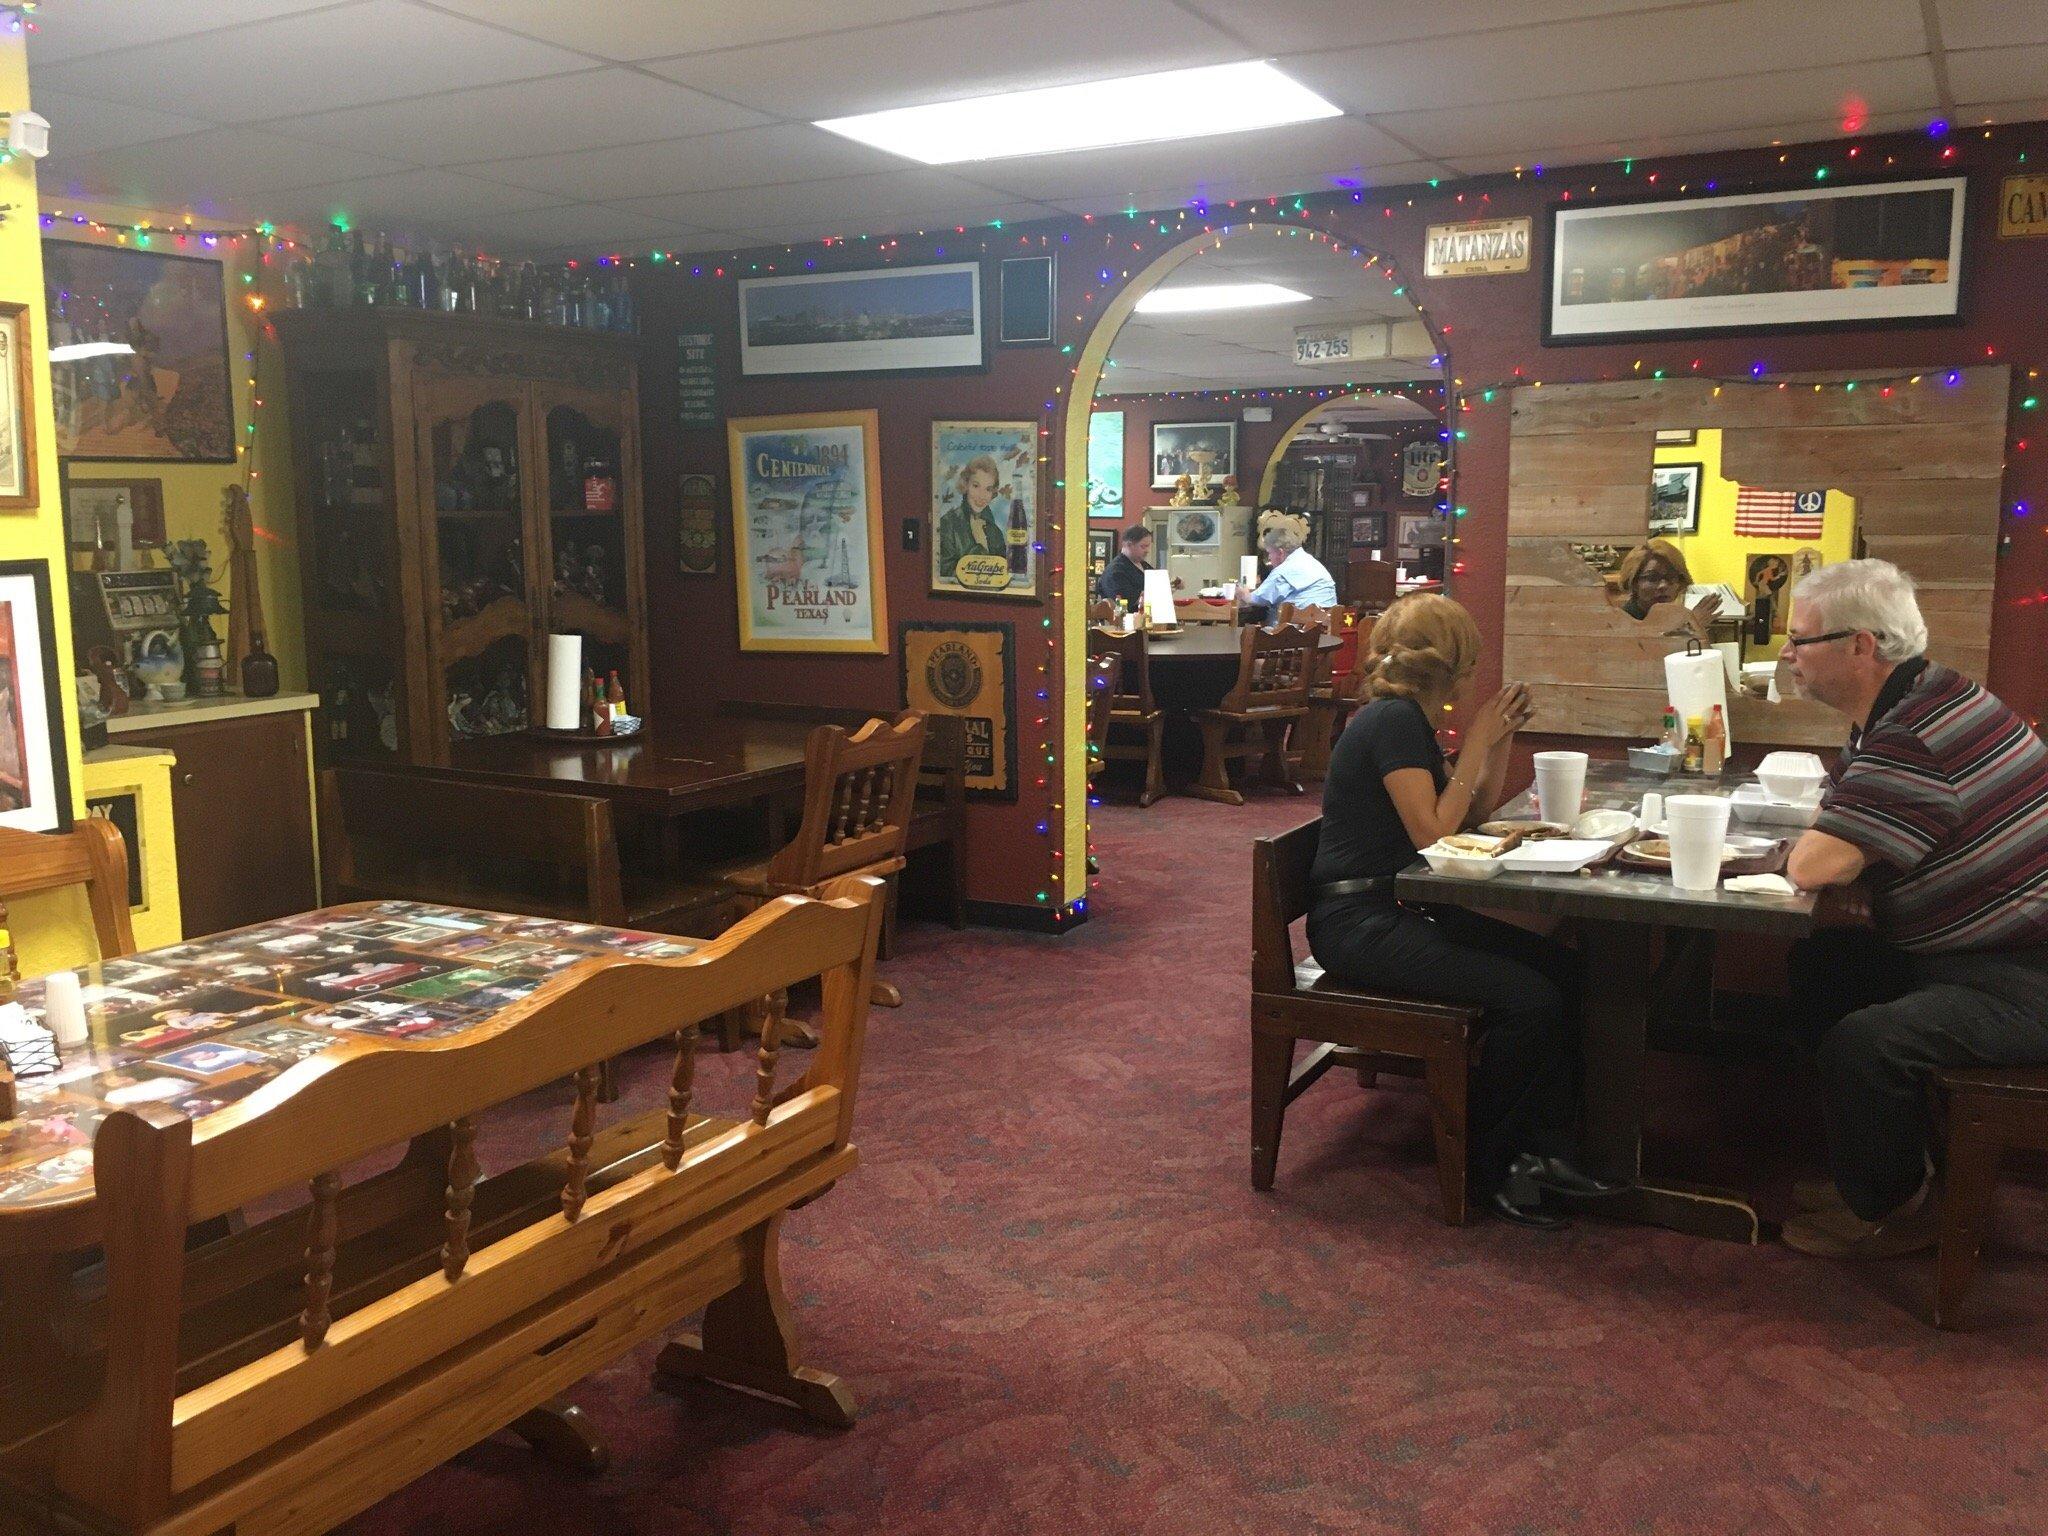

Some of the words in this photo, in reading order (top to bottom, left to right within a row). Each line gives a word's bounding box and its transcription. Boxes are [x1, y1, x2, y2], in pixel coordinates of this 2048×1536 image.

[1432, 230, 1525, 265] MATANZAS
[814, 444, 848, 467] 1894
[1410, 450, 1437, 466] Lite
[965, 560, 1005, 577] NuGrape
[794, 608, 829, 622] TEXAS
[929, 643, 979, 668] PEARLAND
